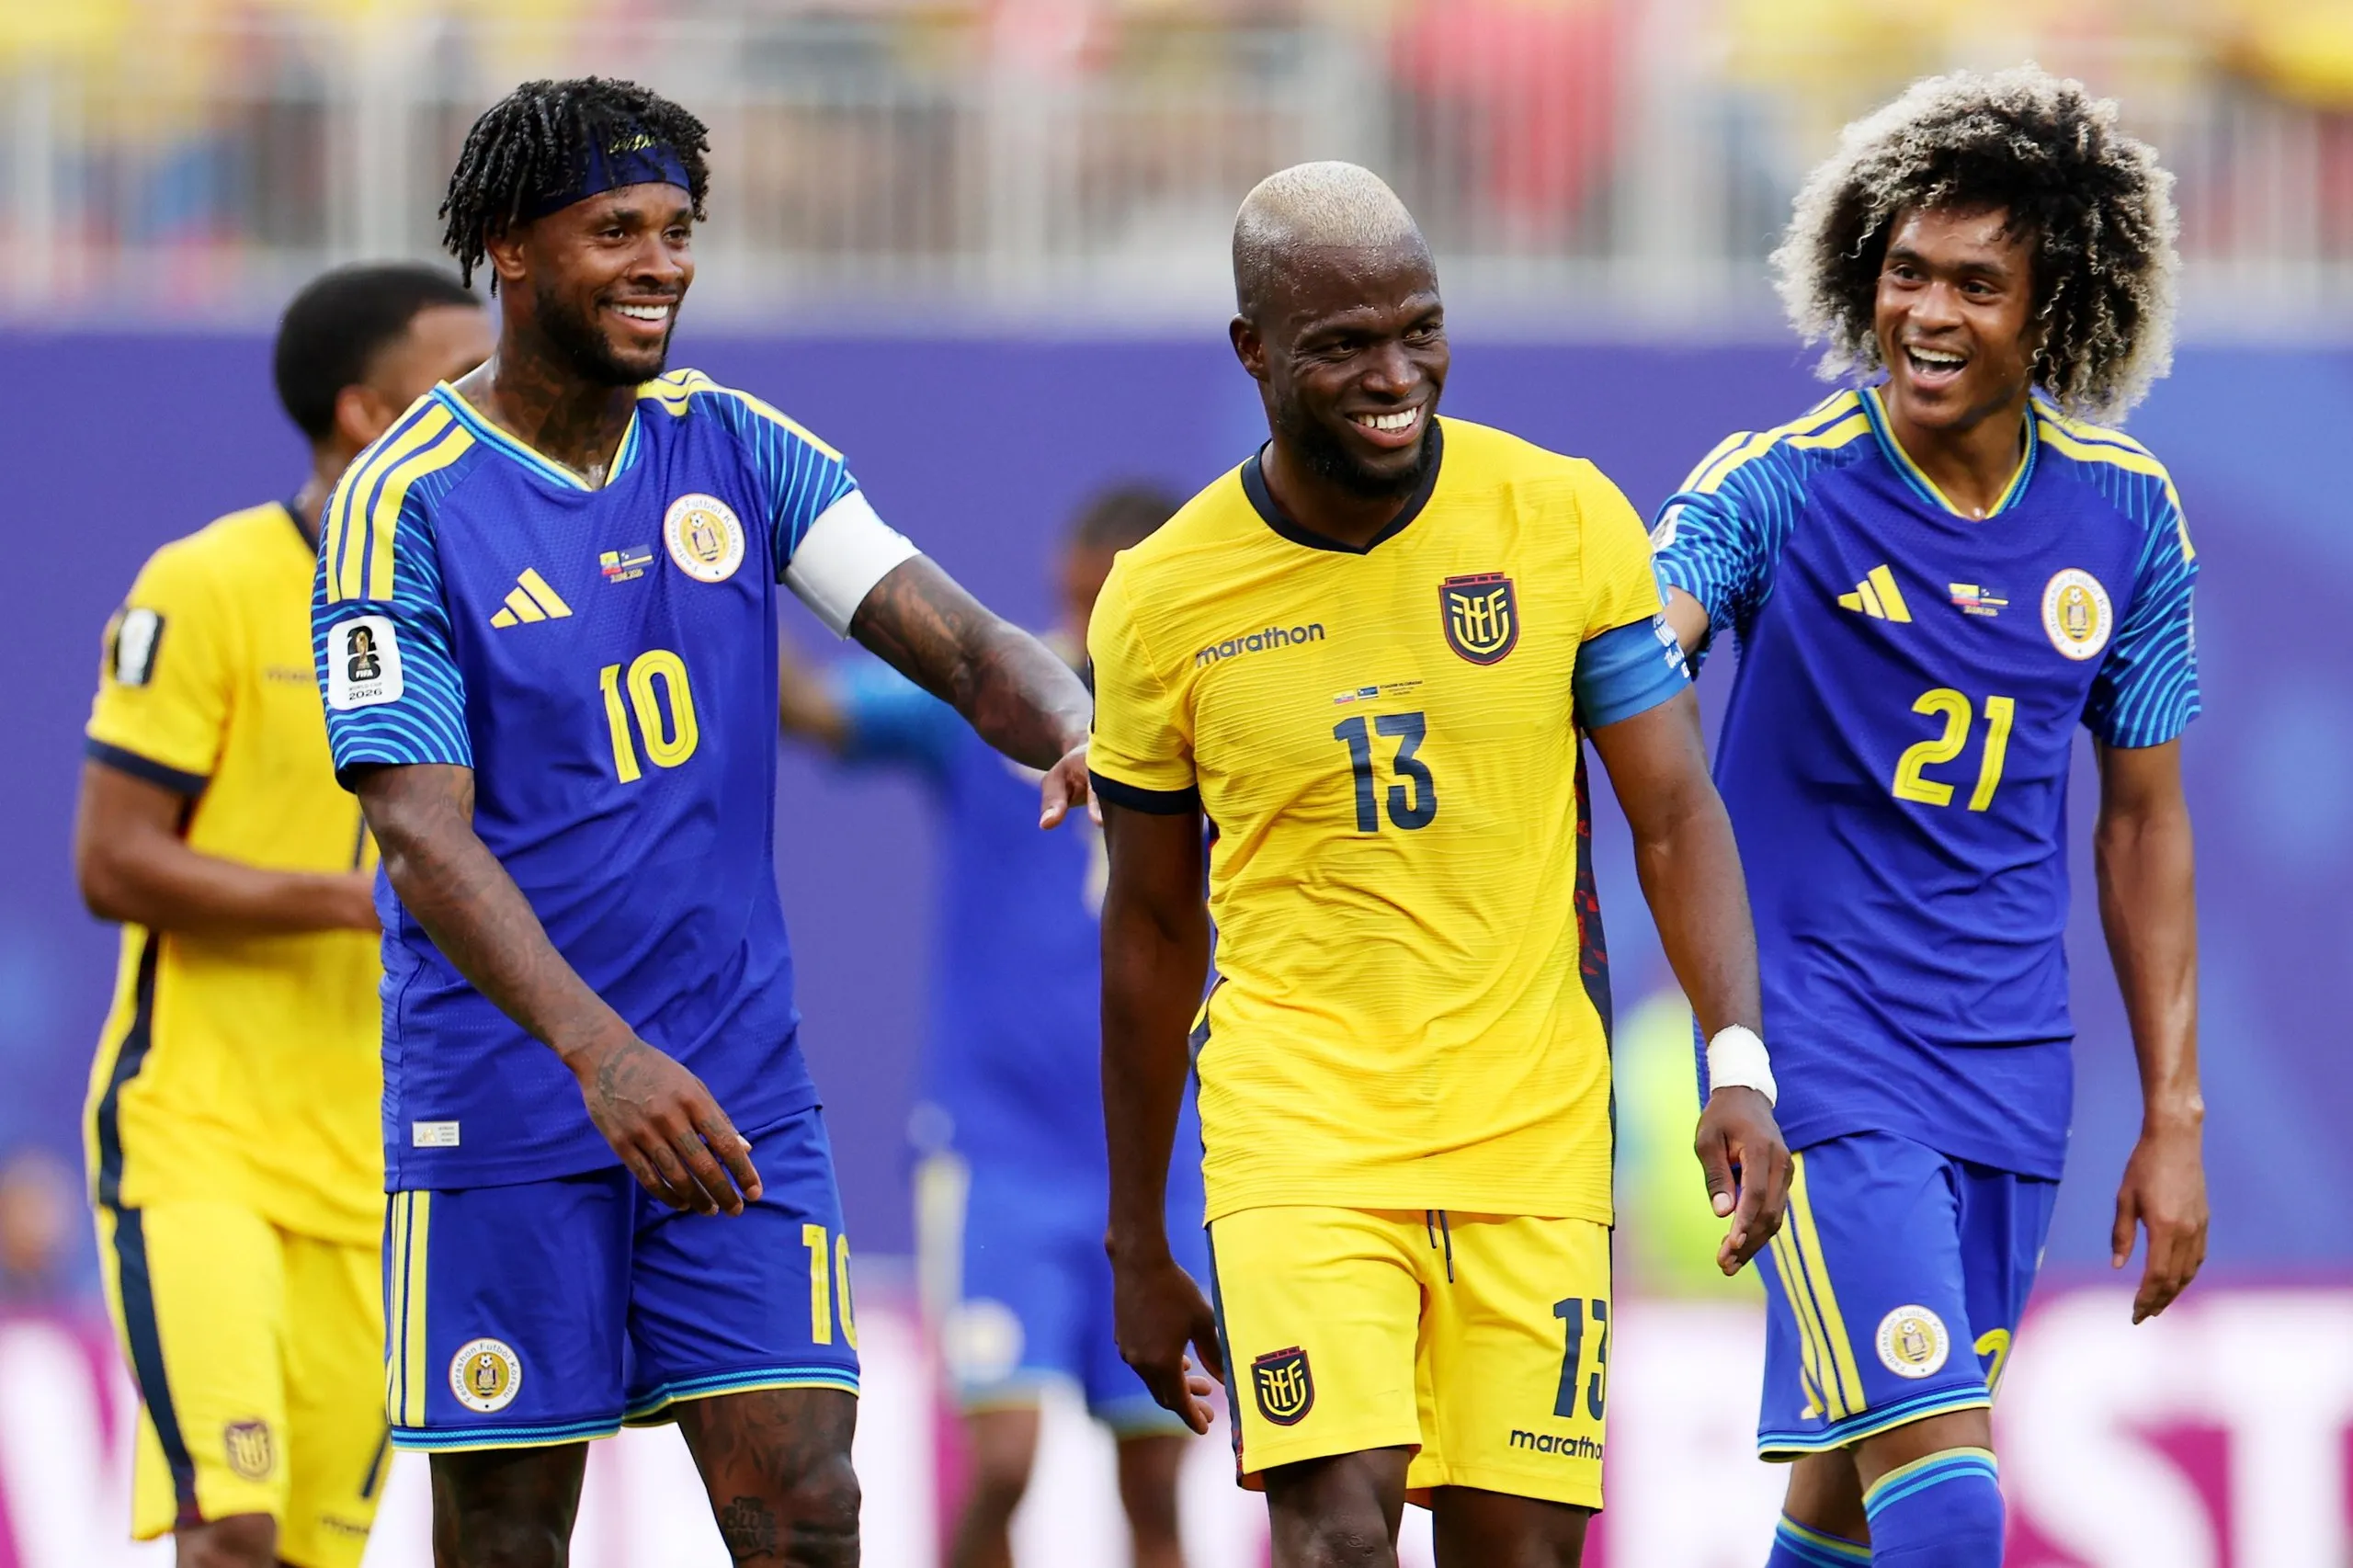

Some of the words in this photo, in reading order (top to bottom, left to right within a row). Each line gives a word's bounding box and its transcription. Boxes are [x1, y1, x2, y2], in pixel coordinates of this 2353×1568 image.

[355, 668, 374, 679] FIFA
[1196, 623, 1325, 668] marathon
[349, 687, 383, 700] 2026
[600, 649, 699, 784] 10
[1333, 711, 1438, 833] 13
[1892, 687, 2015, 812] 21
